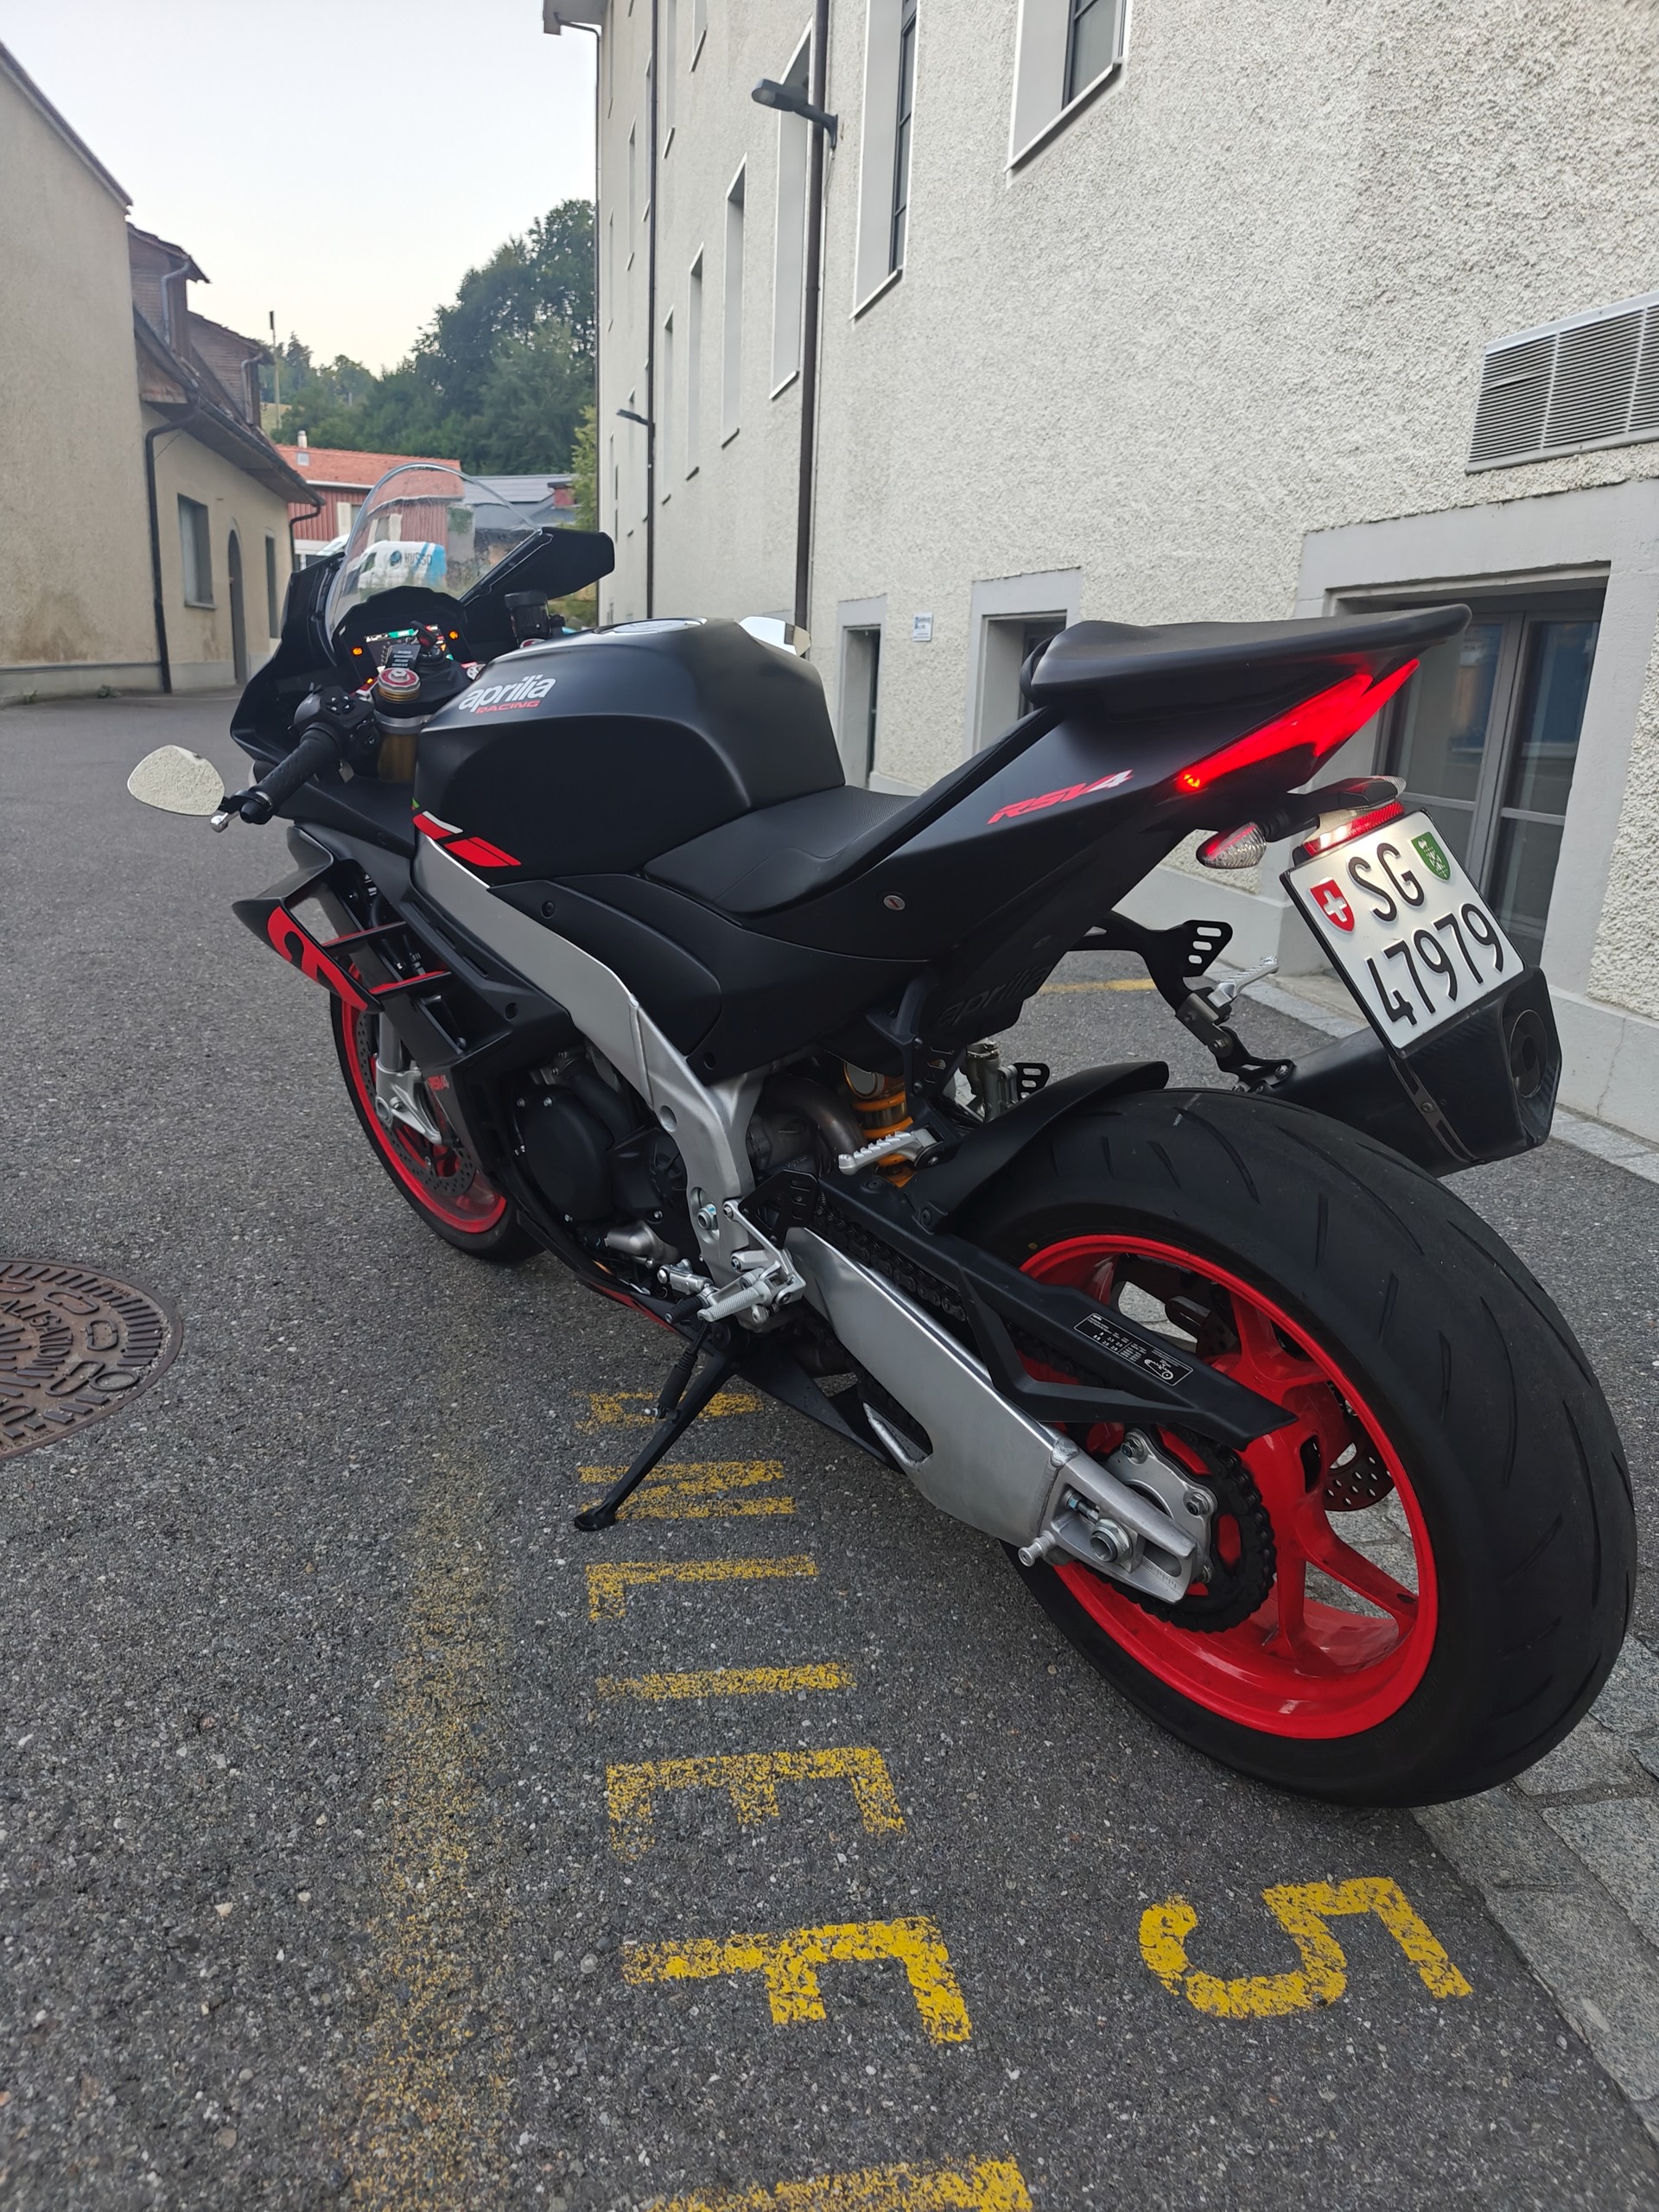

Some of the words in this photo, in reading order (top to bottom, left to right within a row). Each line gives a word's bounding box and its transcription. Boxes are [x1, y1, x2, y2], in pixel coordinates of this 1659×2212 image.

[458, 674, 556, 713] aprilia
[474, 700, 541, 714] RACING
[987, 769, 1134, 824] RSV4
[1345, 842, 1426, 923] SG
[1362, 902, 1504, 1027] 47979
[1138, 1876, 1474, 2020] 5
